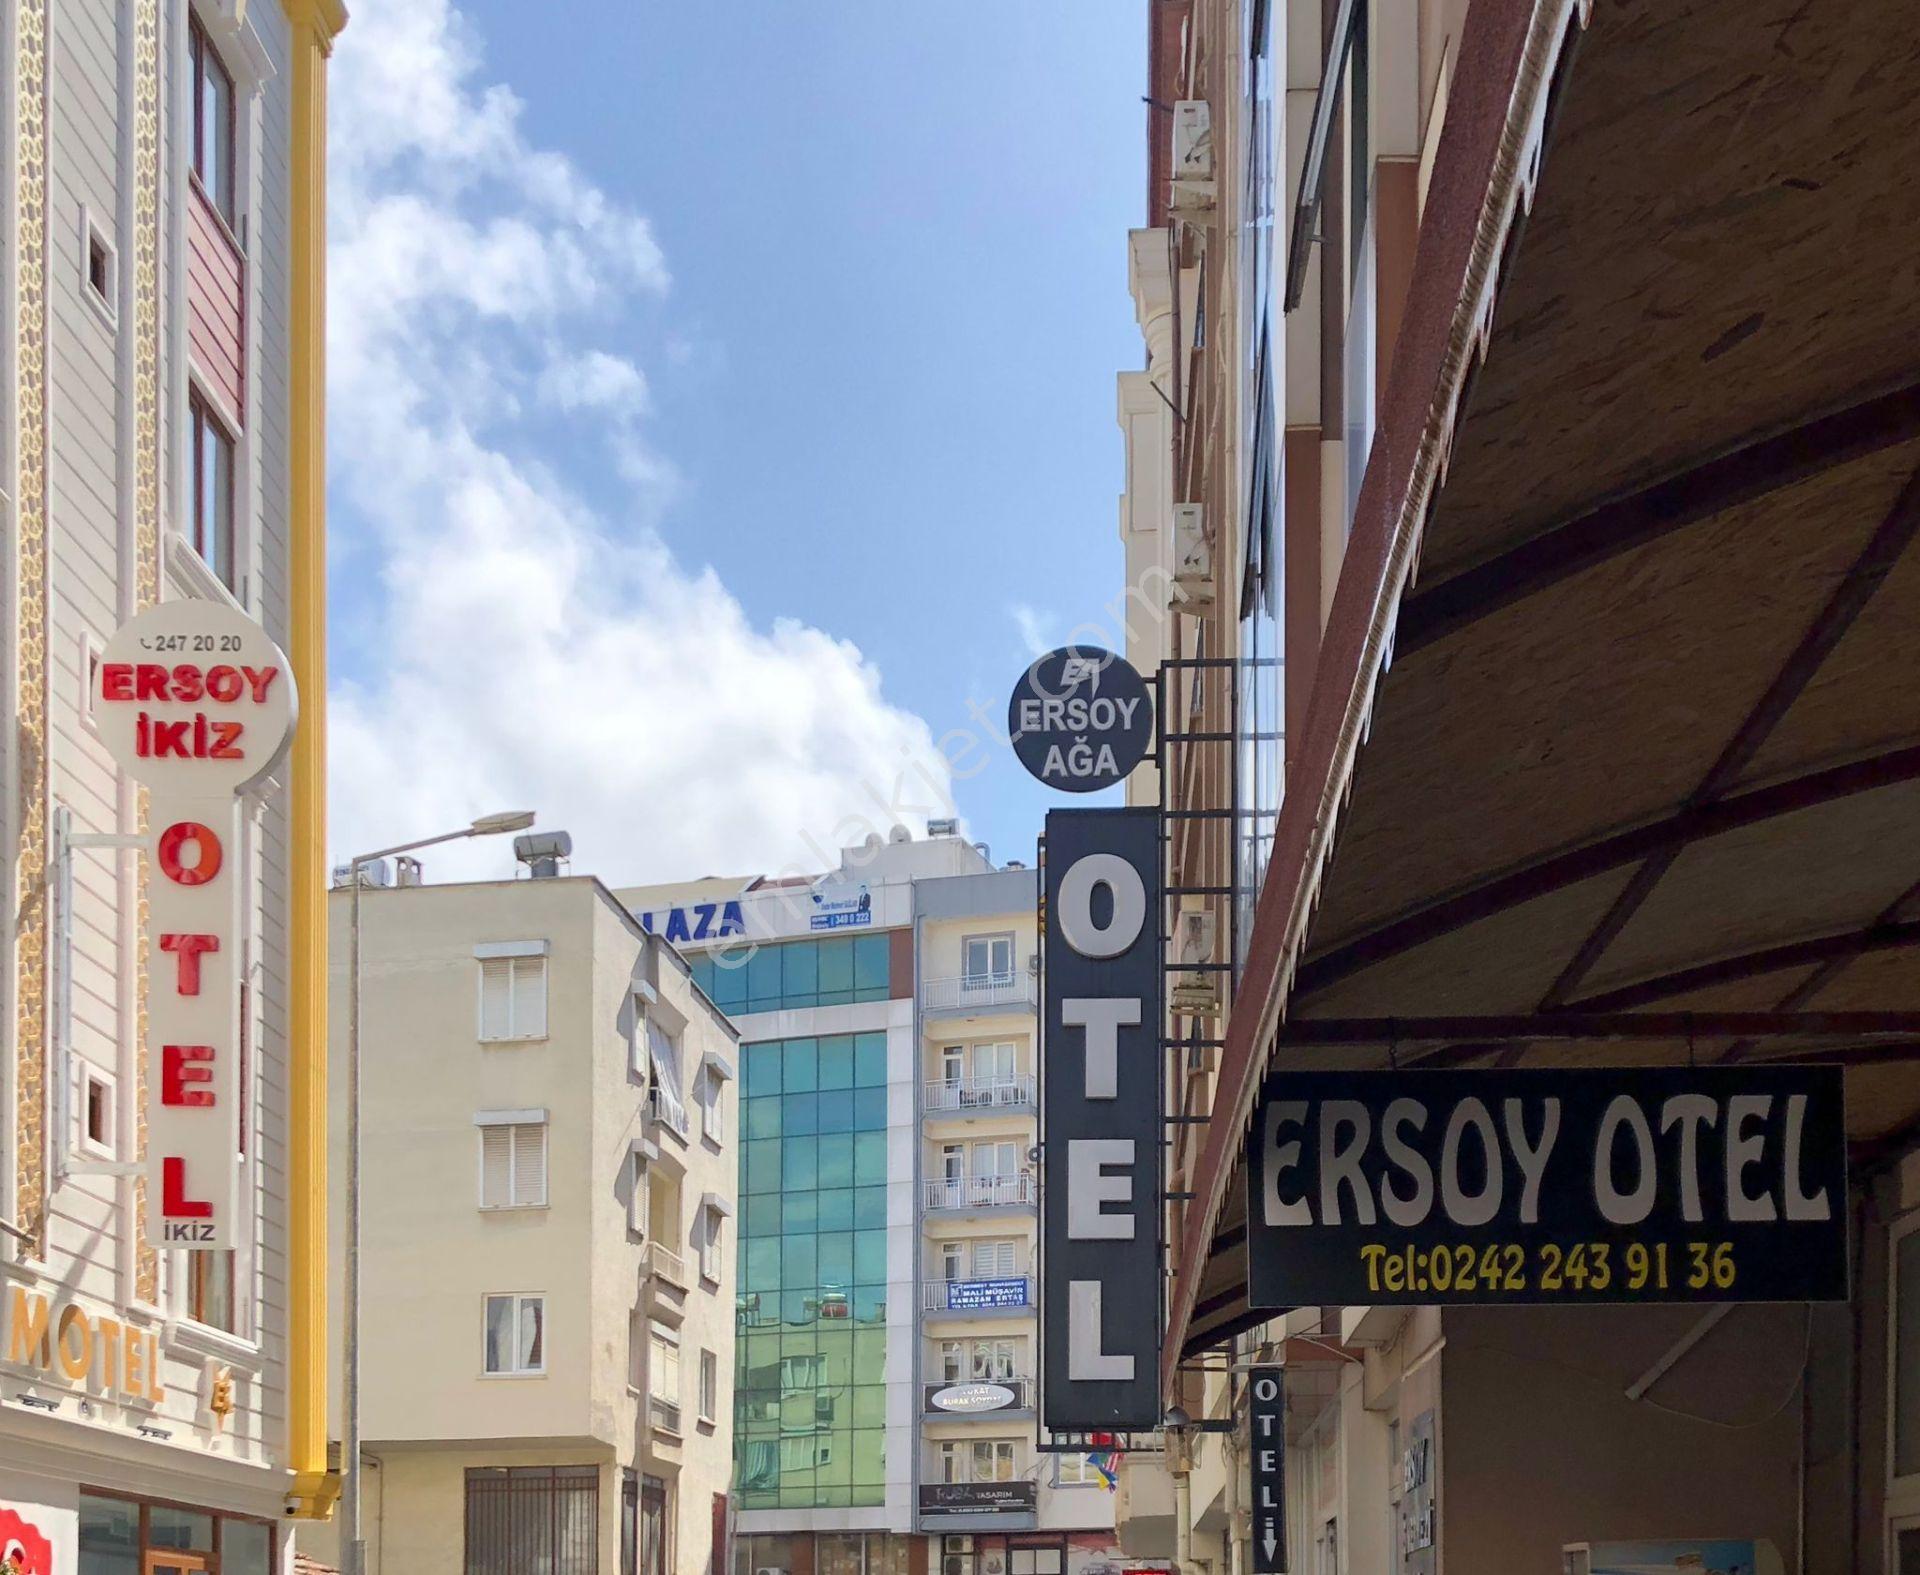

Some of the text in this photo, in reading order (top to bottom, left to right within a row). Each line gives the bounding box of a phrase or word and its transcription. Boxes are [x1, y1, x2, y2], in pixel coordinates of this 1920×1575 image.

[155, 635, 242, 652] 247 20 20
[102, 663, 279, 704] ERSOY
[136, 711, 245, 759] İKİZ
[1020, 697, 1141, 732] ERSOY
[1042, 735, 1121, 778] AĞA
[158, 821, 223, 1218] OTEL
[1057, 852, 1147, 1381] OTEL
[1263, 1093, 1831, 1227] ERSOY OTEL
[164, 1219, 216, 1242] İKİZ
[1360, 1241, 1737, 1292] Tel:0242 243 91 36
[7, 1284, 165, 1404] MOTEL
[1254, 1378, 1278, 1508] OTEL
[976, 1491, 1013, 1499] TASARIM
